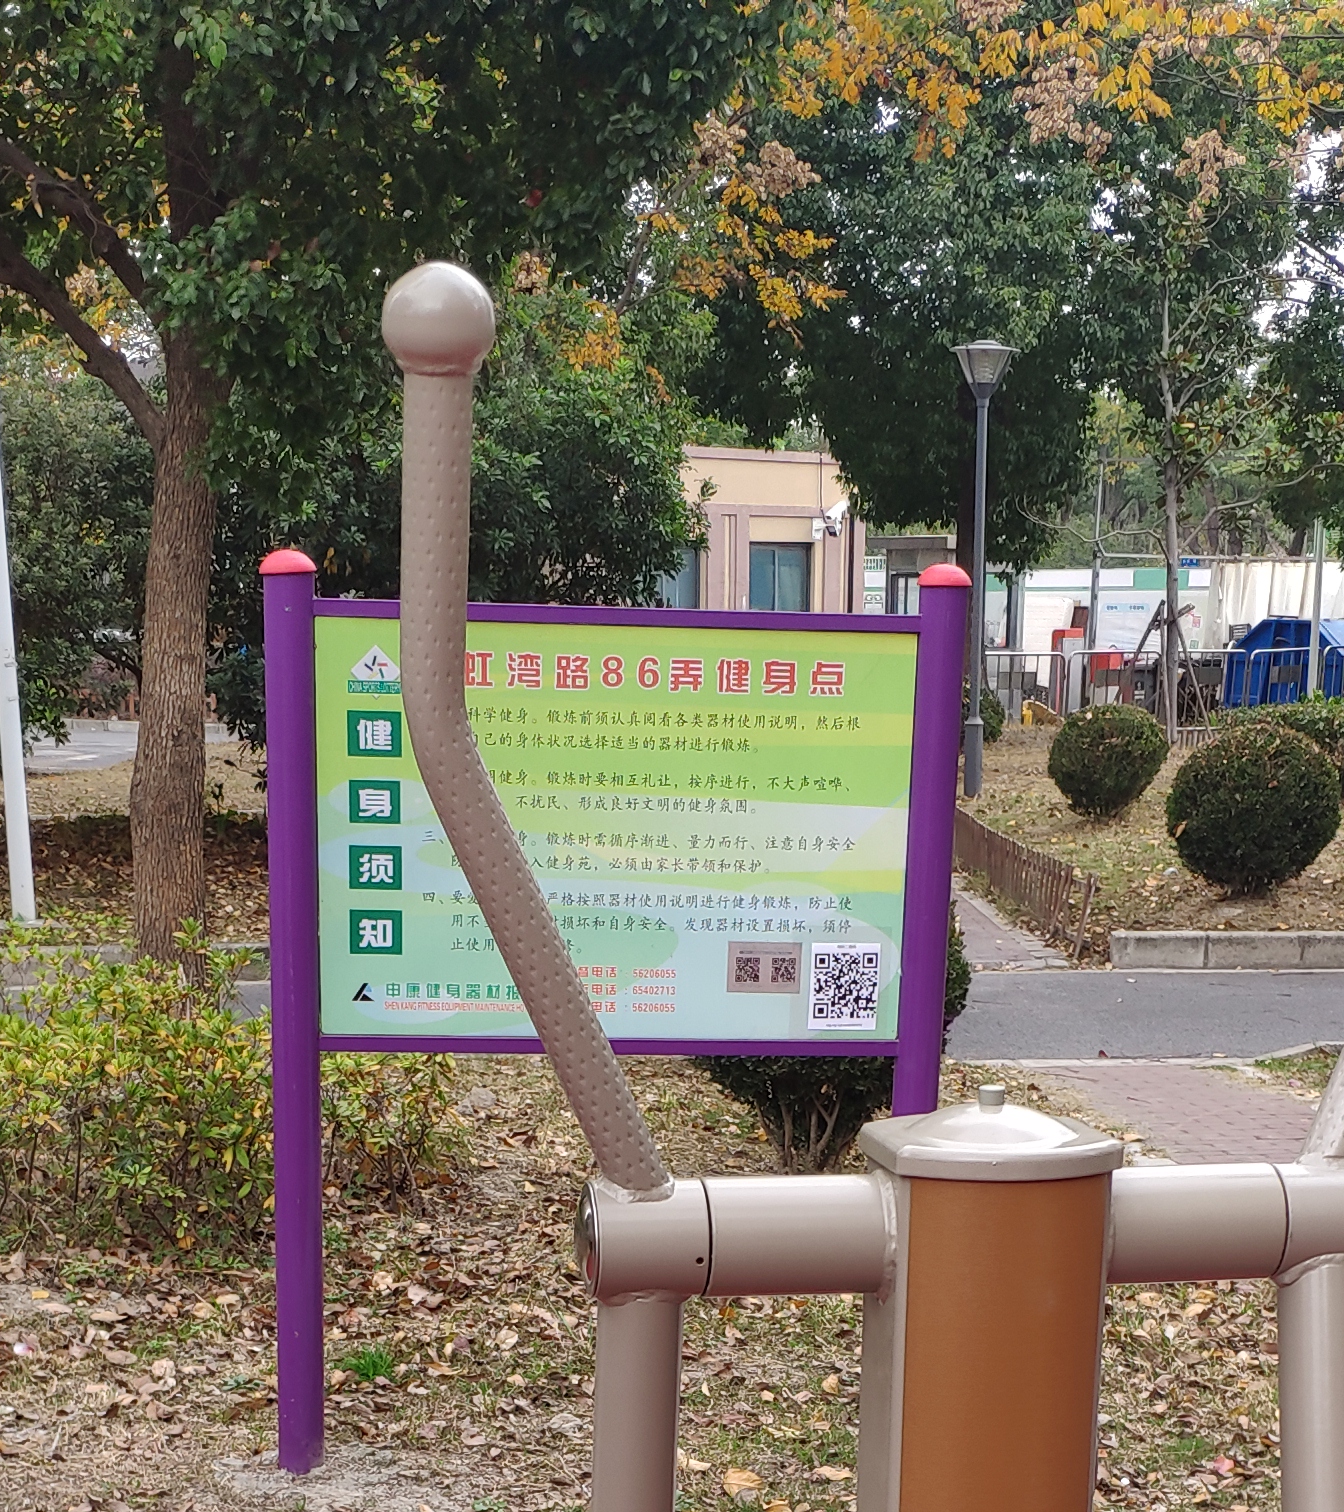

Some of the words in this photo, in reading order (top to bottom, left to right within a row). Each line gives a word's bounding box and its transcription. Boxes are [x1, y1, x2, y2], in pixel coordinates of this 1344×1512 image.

[465, 651, 845, 696] 虹湾路86弄健身点
[384, 1002, 400, 1011] SHEN
[401, 1002, 417, 1011] KANG
[418, 1002, 441, 1011] FITNESS
[442, 1002, 474, 1012] EQUIPMENT
